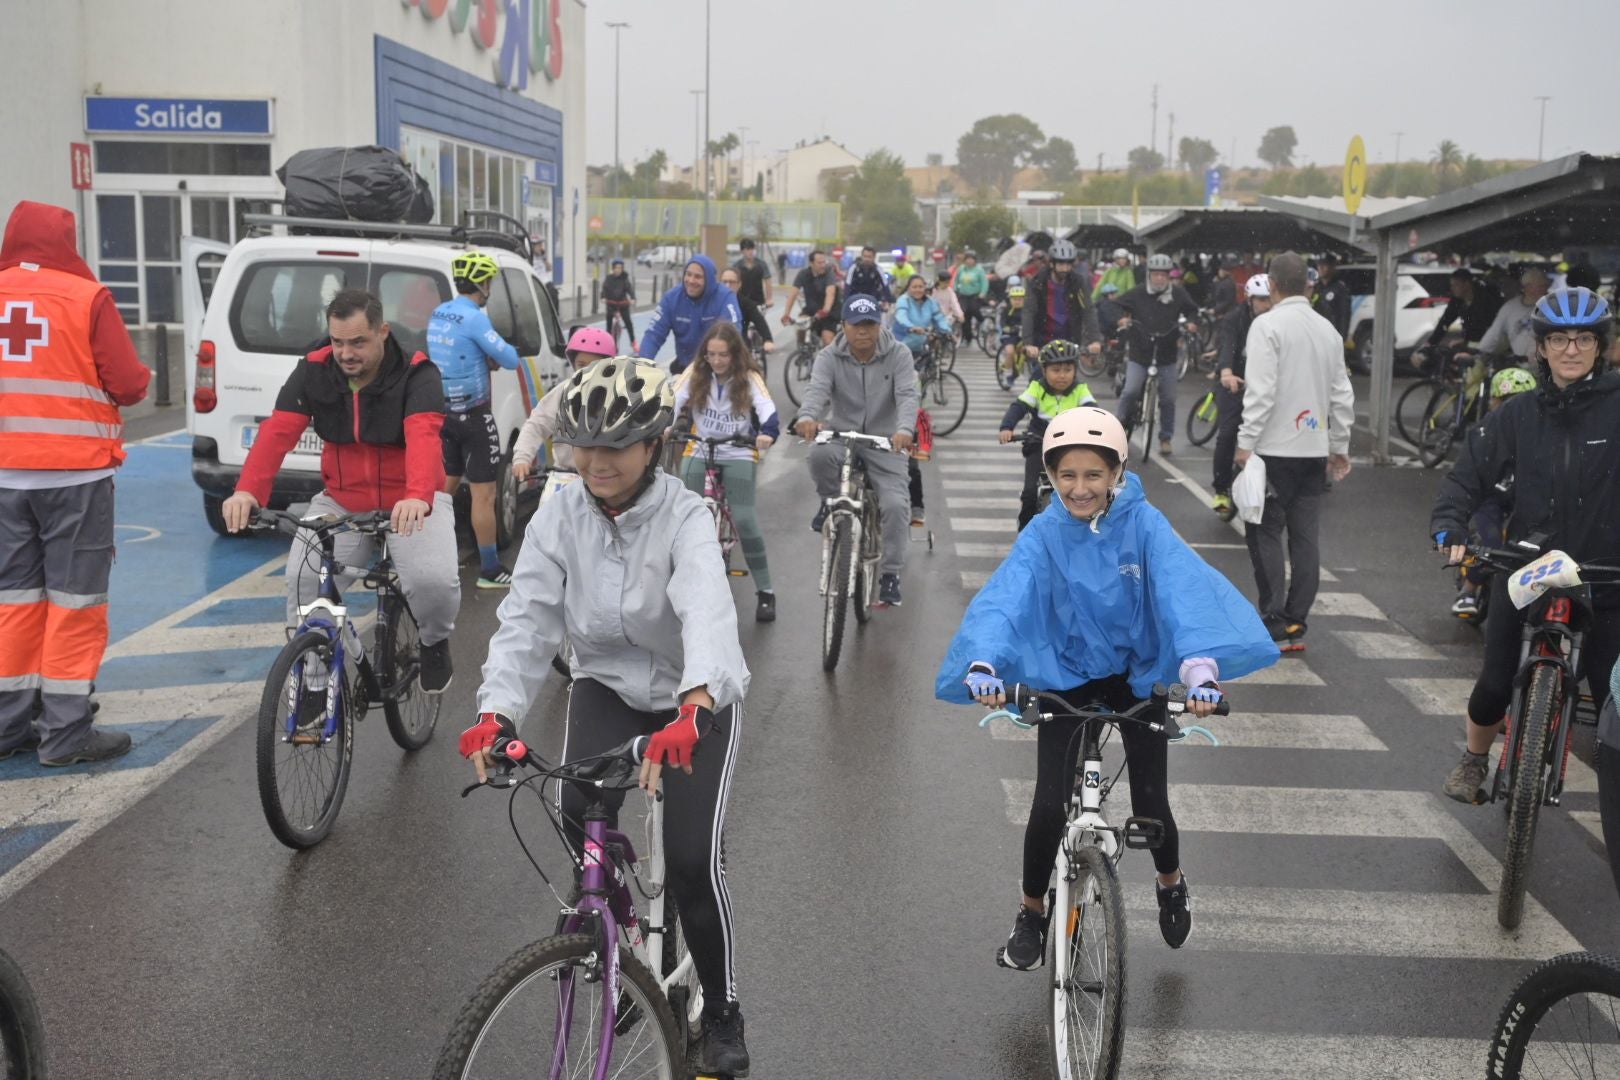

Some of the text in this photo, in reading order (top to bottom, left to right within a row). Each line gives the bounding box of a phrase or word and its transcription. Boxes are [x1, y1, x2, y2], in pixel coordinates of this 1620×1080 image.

[135, 103, 222, 129] Salida
[1349, 155, 1360, 195] C
[483, 414, 500, 465] ASFAS
[1493, 1002, 1526, 1079] MAXXIS
